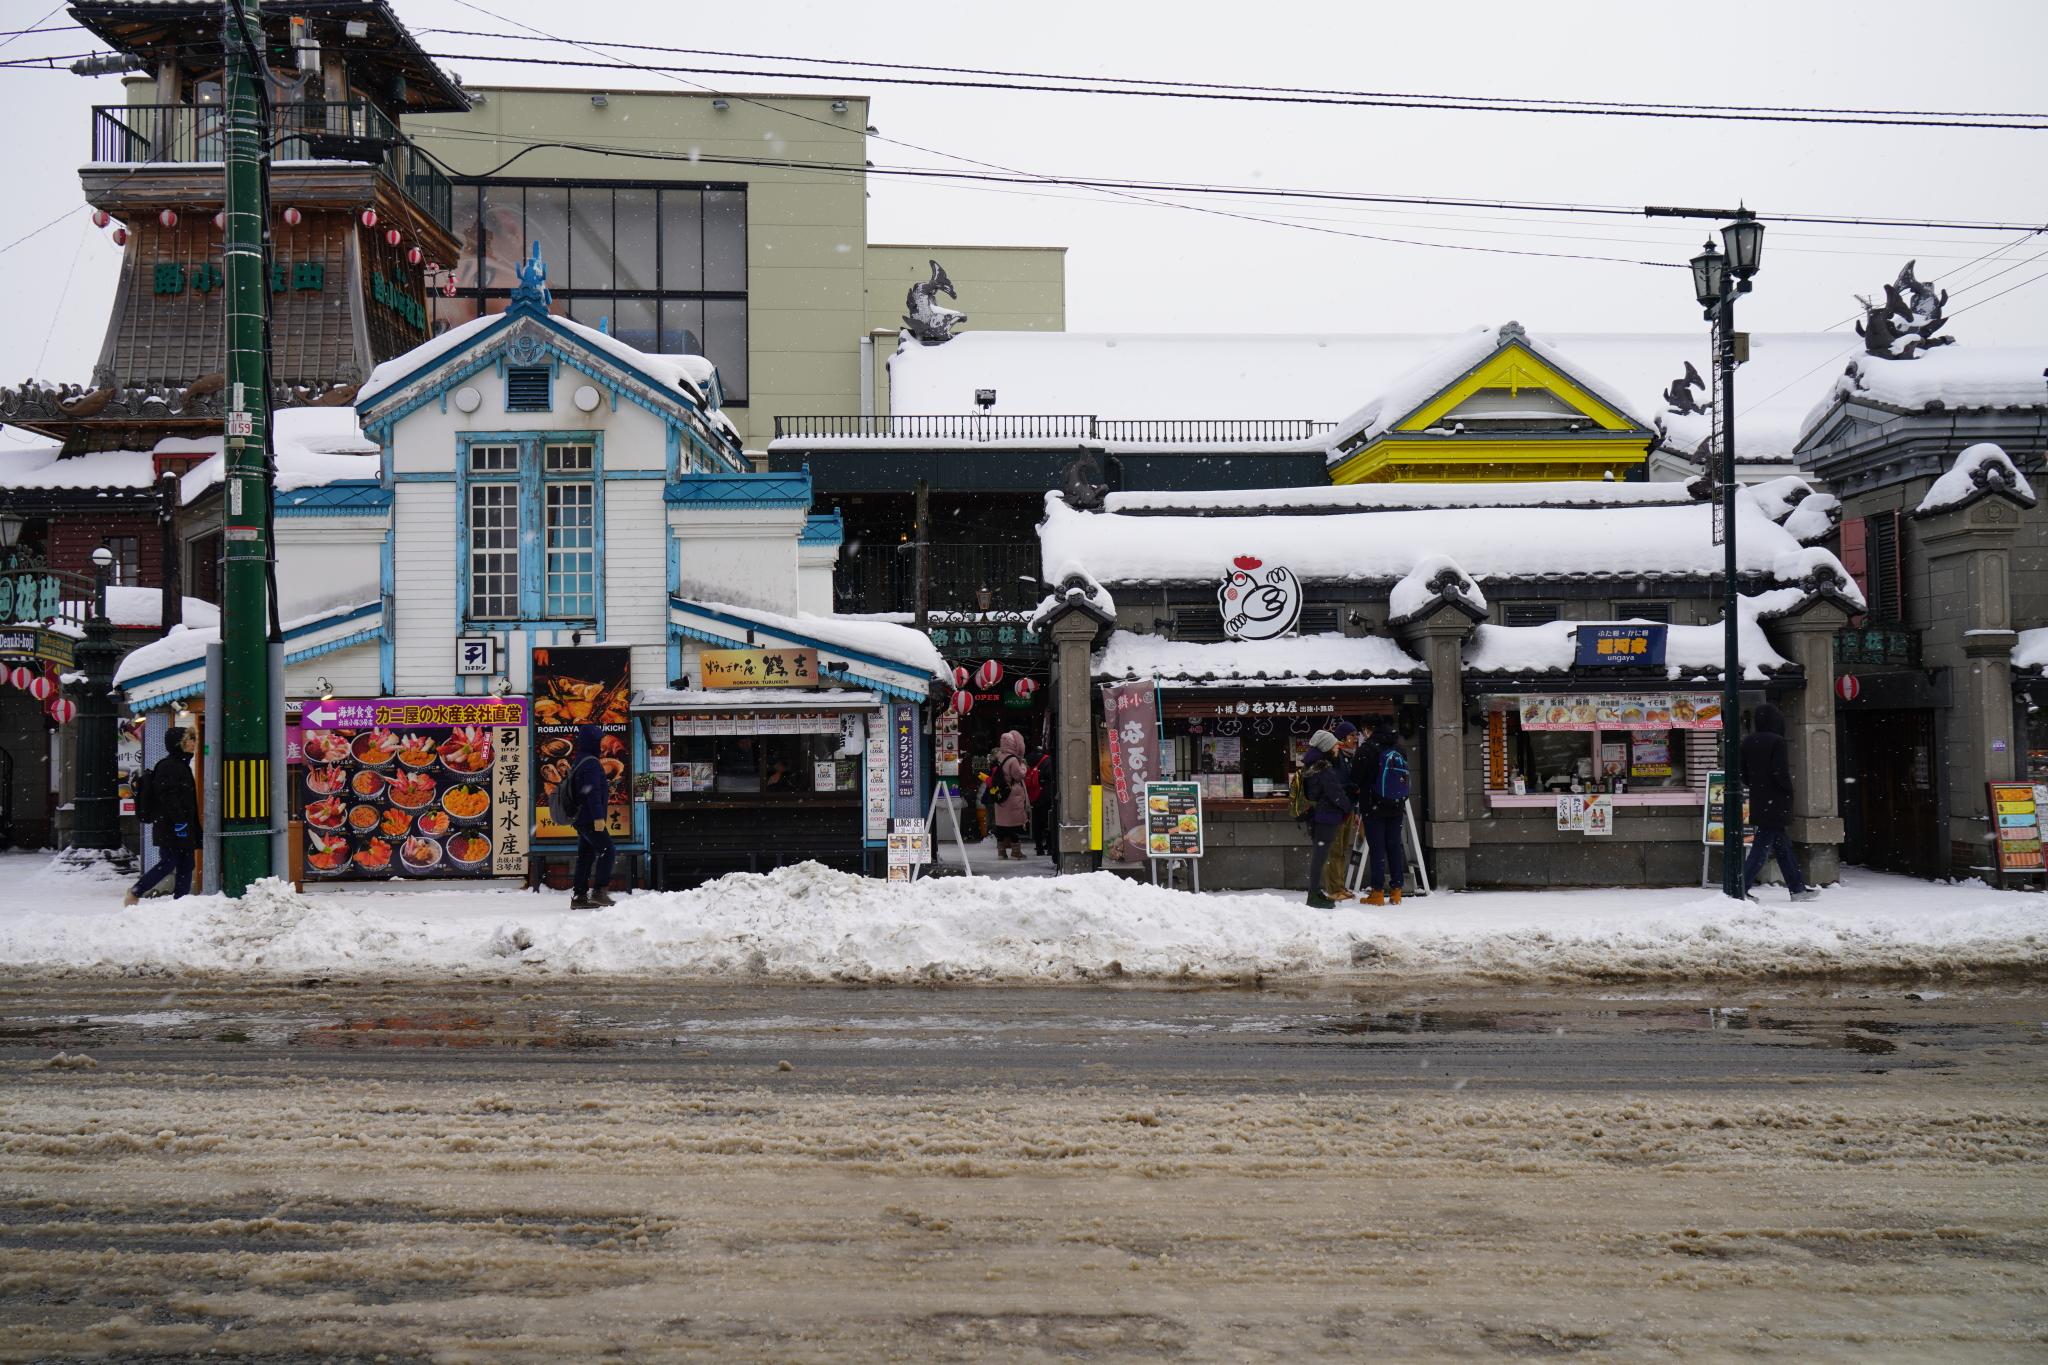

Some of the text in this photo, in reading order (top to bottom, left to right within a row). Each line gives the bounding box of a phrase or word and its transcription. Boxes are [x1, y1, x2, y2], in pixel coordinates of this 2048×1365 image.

[1597, 637, 1648, 654] 運河家
[1607, 655, 1635, 663] ungaya
[338, 706, 374, 719] 海鮮食堂
[375, 704, 522, 725] カニ屋の水産会社直営
[1214, 705, 1234, 714] 小樽
[537, 725, 580, 733] ROBATAYA
[500, 754, 520, 763] 根室
[900, 736, 909, 778] クラシック
[499, 764, 521, 856] 澤崎水産
[896, 818, 923, 828] LUNCH SET
